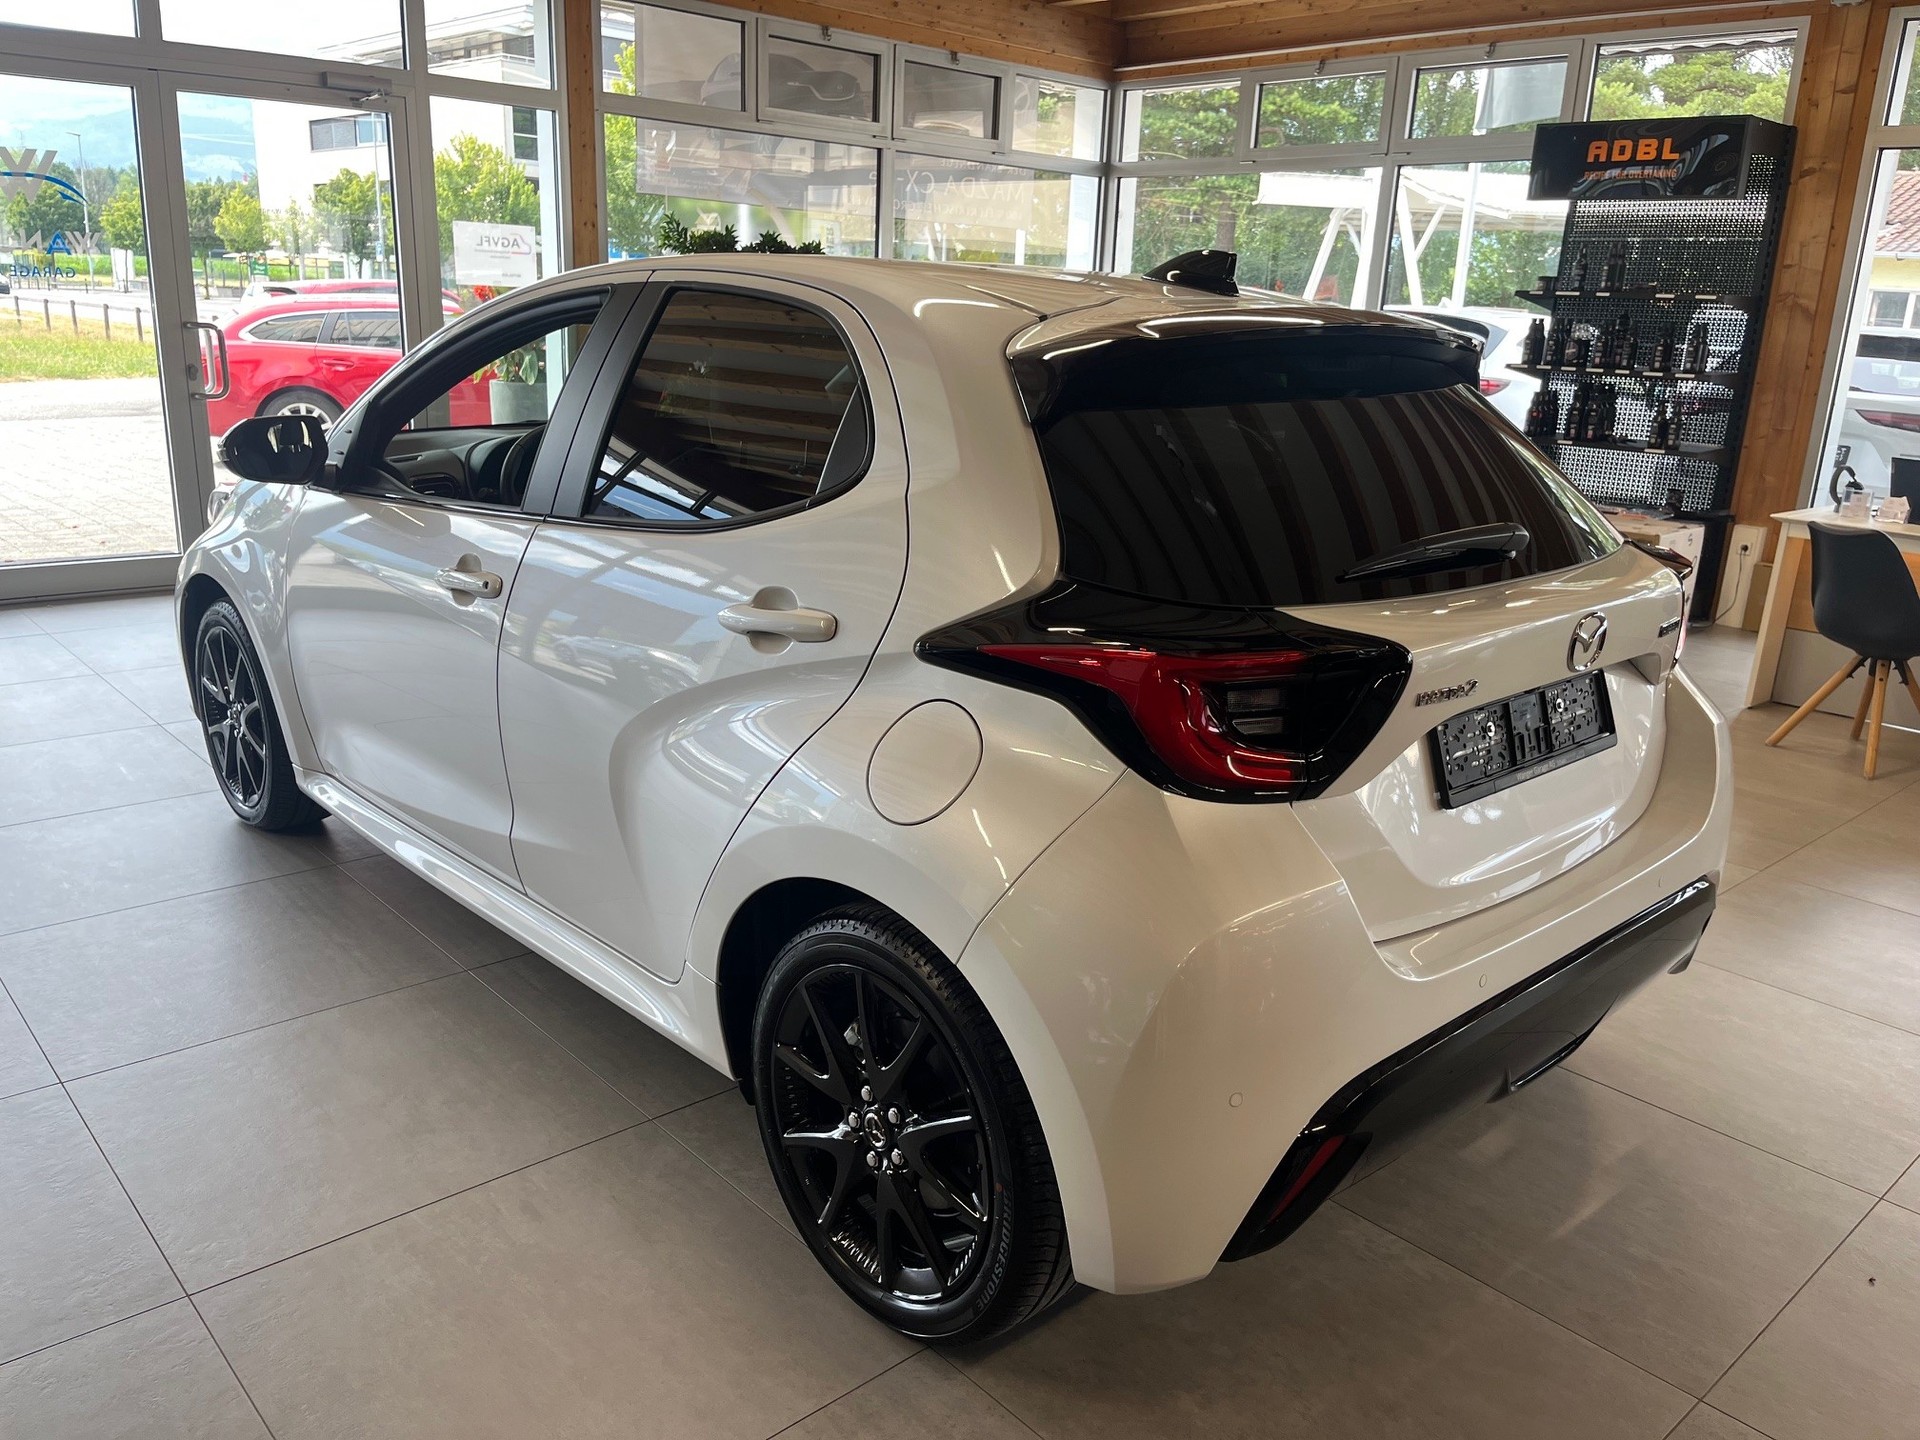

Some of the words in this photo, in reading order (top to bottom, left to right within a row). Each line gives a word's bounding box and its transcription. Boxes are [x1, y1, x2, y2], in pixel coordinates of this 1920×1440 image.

[1586, 137, 1680, 163] ADBL
[1583, 170, 1609, 180] RECIPE
[1611, 169, 1627, 180] FOR
[1628, 167, 1678, 179] OVERTAKING
[975, 1190, 1012, 1312] BRIDGESTONE
